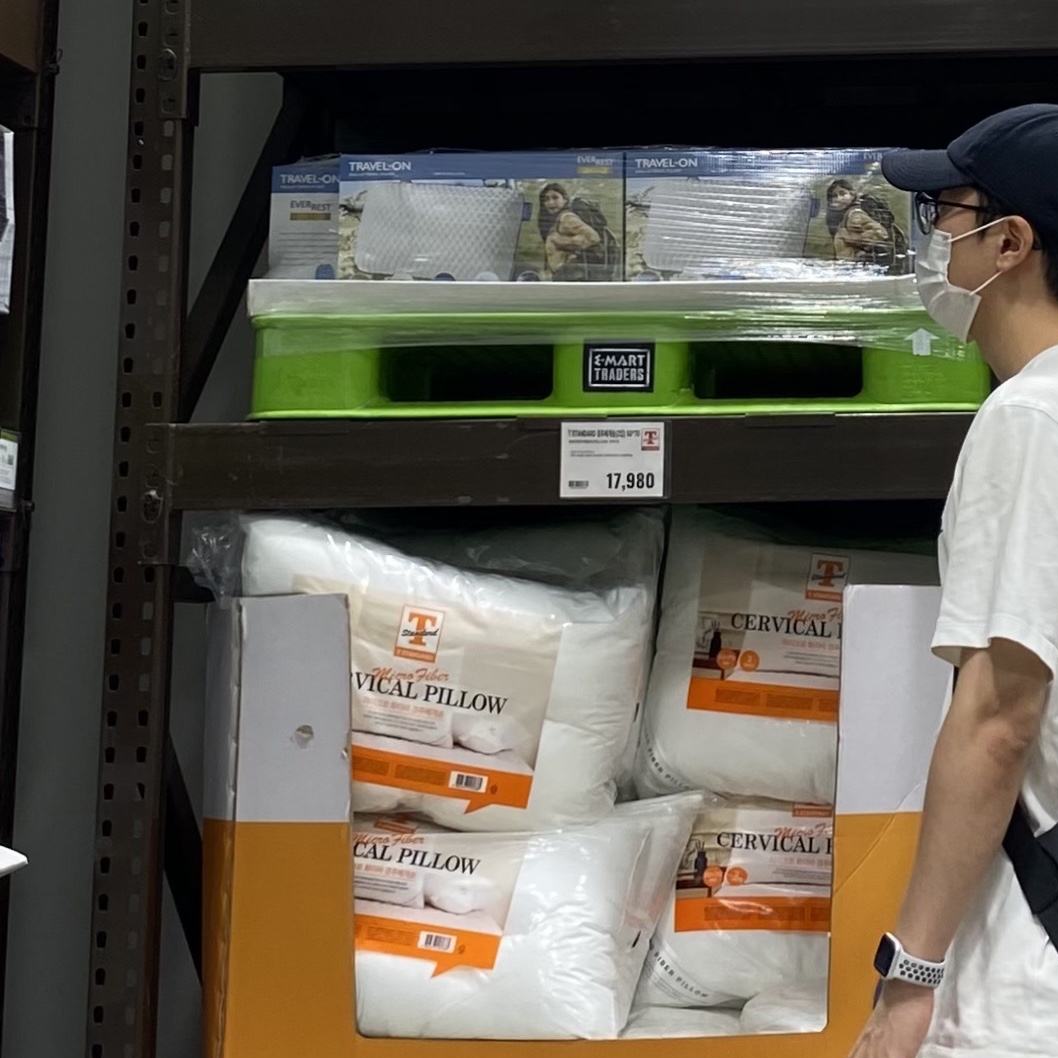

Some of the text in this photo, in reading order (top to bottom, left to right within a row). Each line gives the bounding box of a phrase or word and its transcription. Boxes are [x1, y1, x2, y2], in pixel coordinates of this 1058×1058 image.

[348, 161, 412, 172] TRAVEL-ON
[635, 158, 698, 169] TRAVEL-ON
[594, 368, 644, 381] TRADERS
[606, 472, 655, 491] 17,980
[731, 612, 833, 639] CERVICAL
[423, 684, 509, 716] PILLOW
[716, 831, 821, 855] CERVICAL
[397, 848, 482, 876] PILLOW
